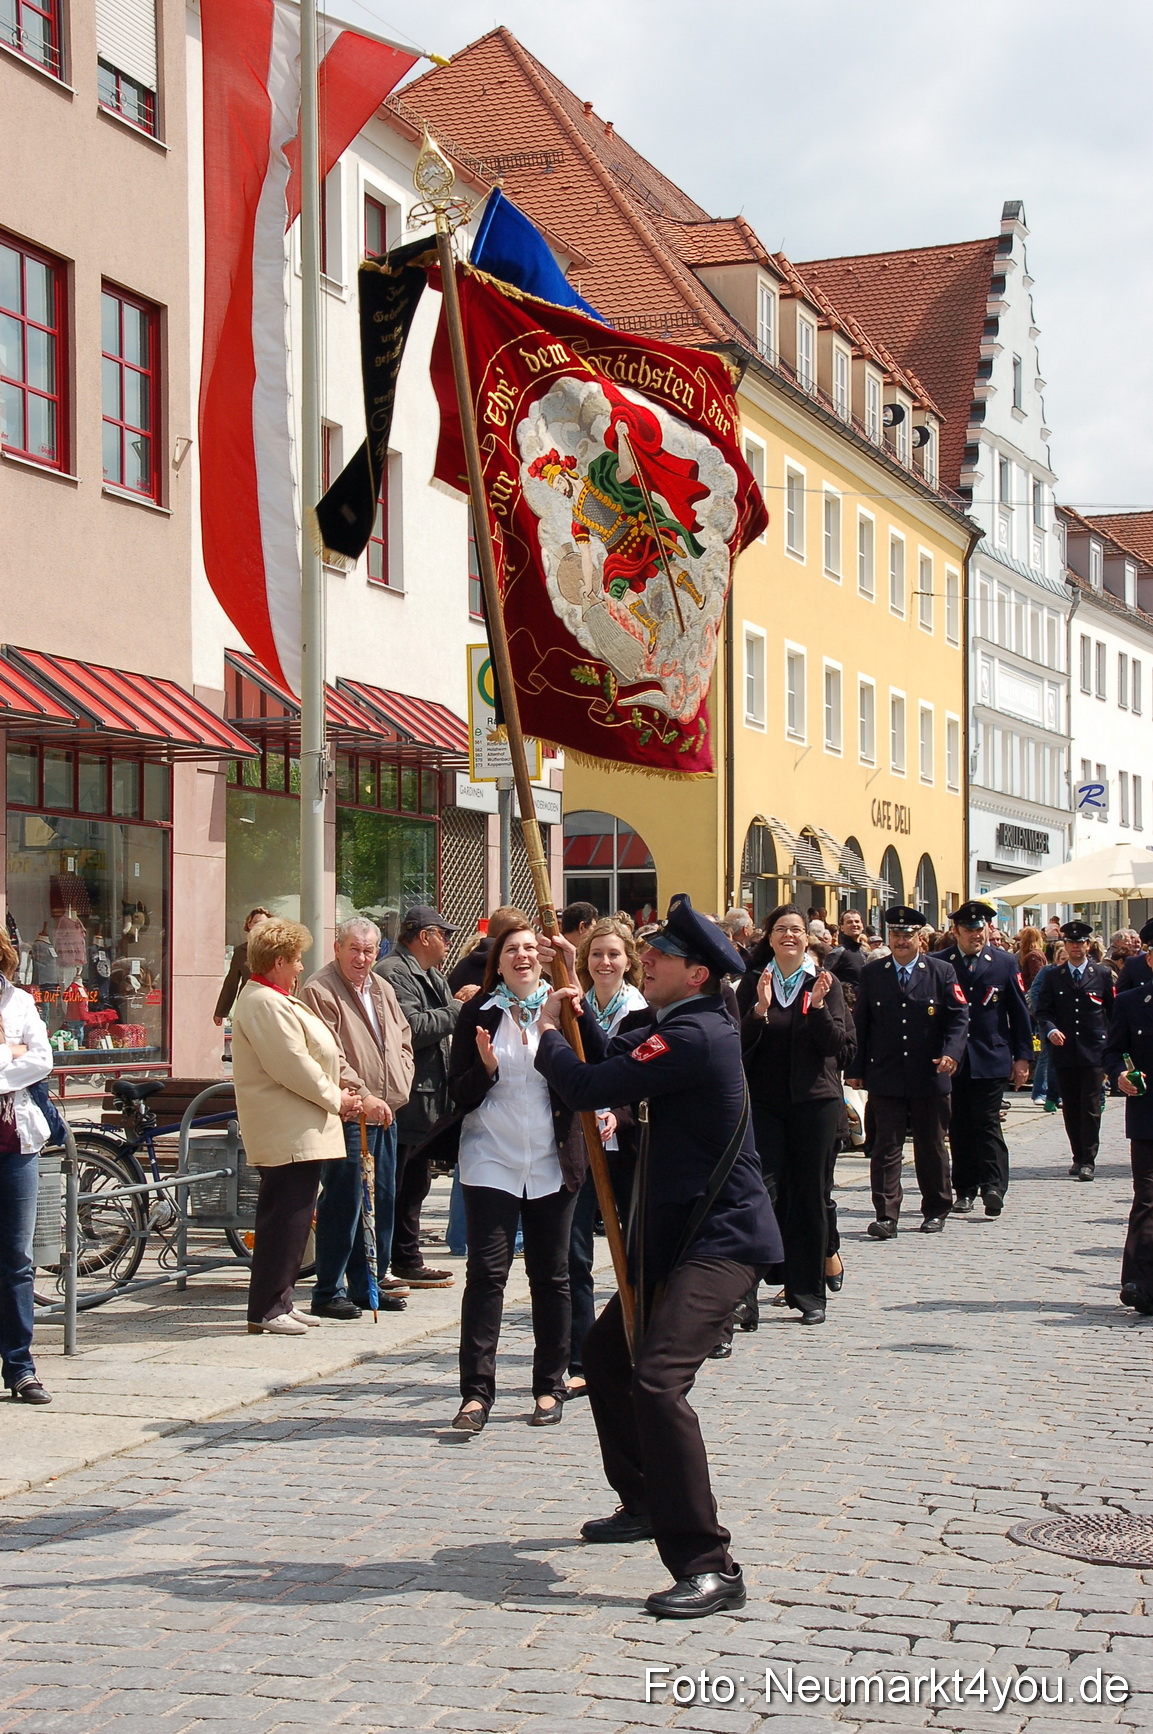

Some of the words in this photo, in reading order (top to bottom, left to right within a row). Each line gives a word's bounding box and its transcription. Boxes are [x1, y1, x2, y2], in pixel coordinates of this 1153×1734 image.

[518, 343, 571, 373] dem
[586, 353, 695, 409] Nächsten
[708, 398, 731, 437] zur
[460, 784, 484, 798] GARDINEN
[871, 798, 892, 831] CAFE
[893, 802, 911, 836] DELI
[1002, 823, 1029, 850] BRILLEN
[1028, 829, 1050, 854] WEBER
